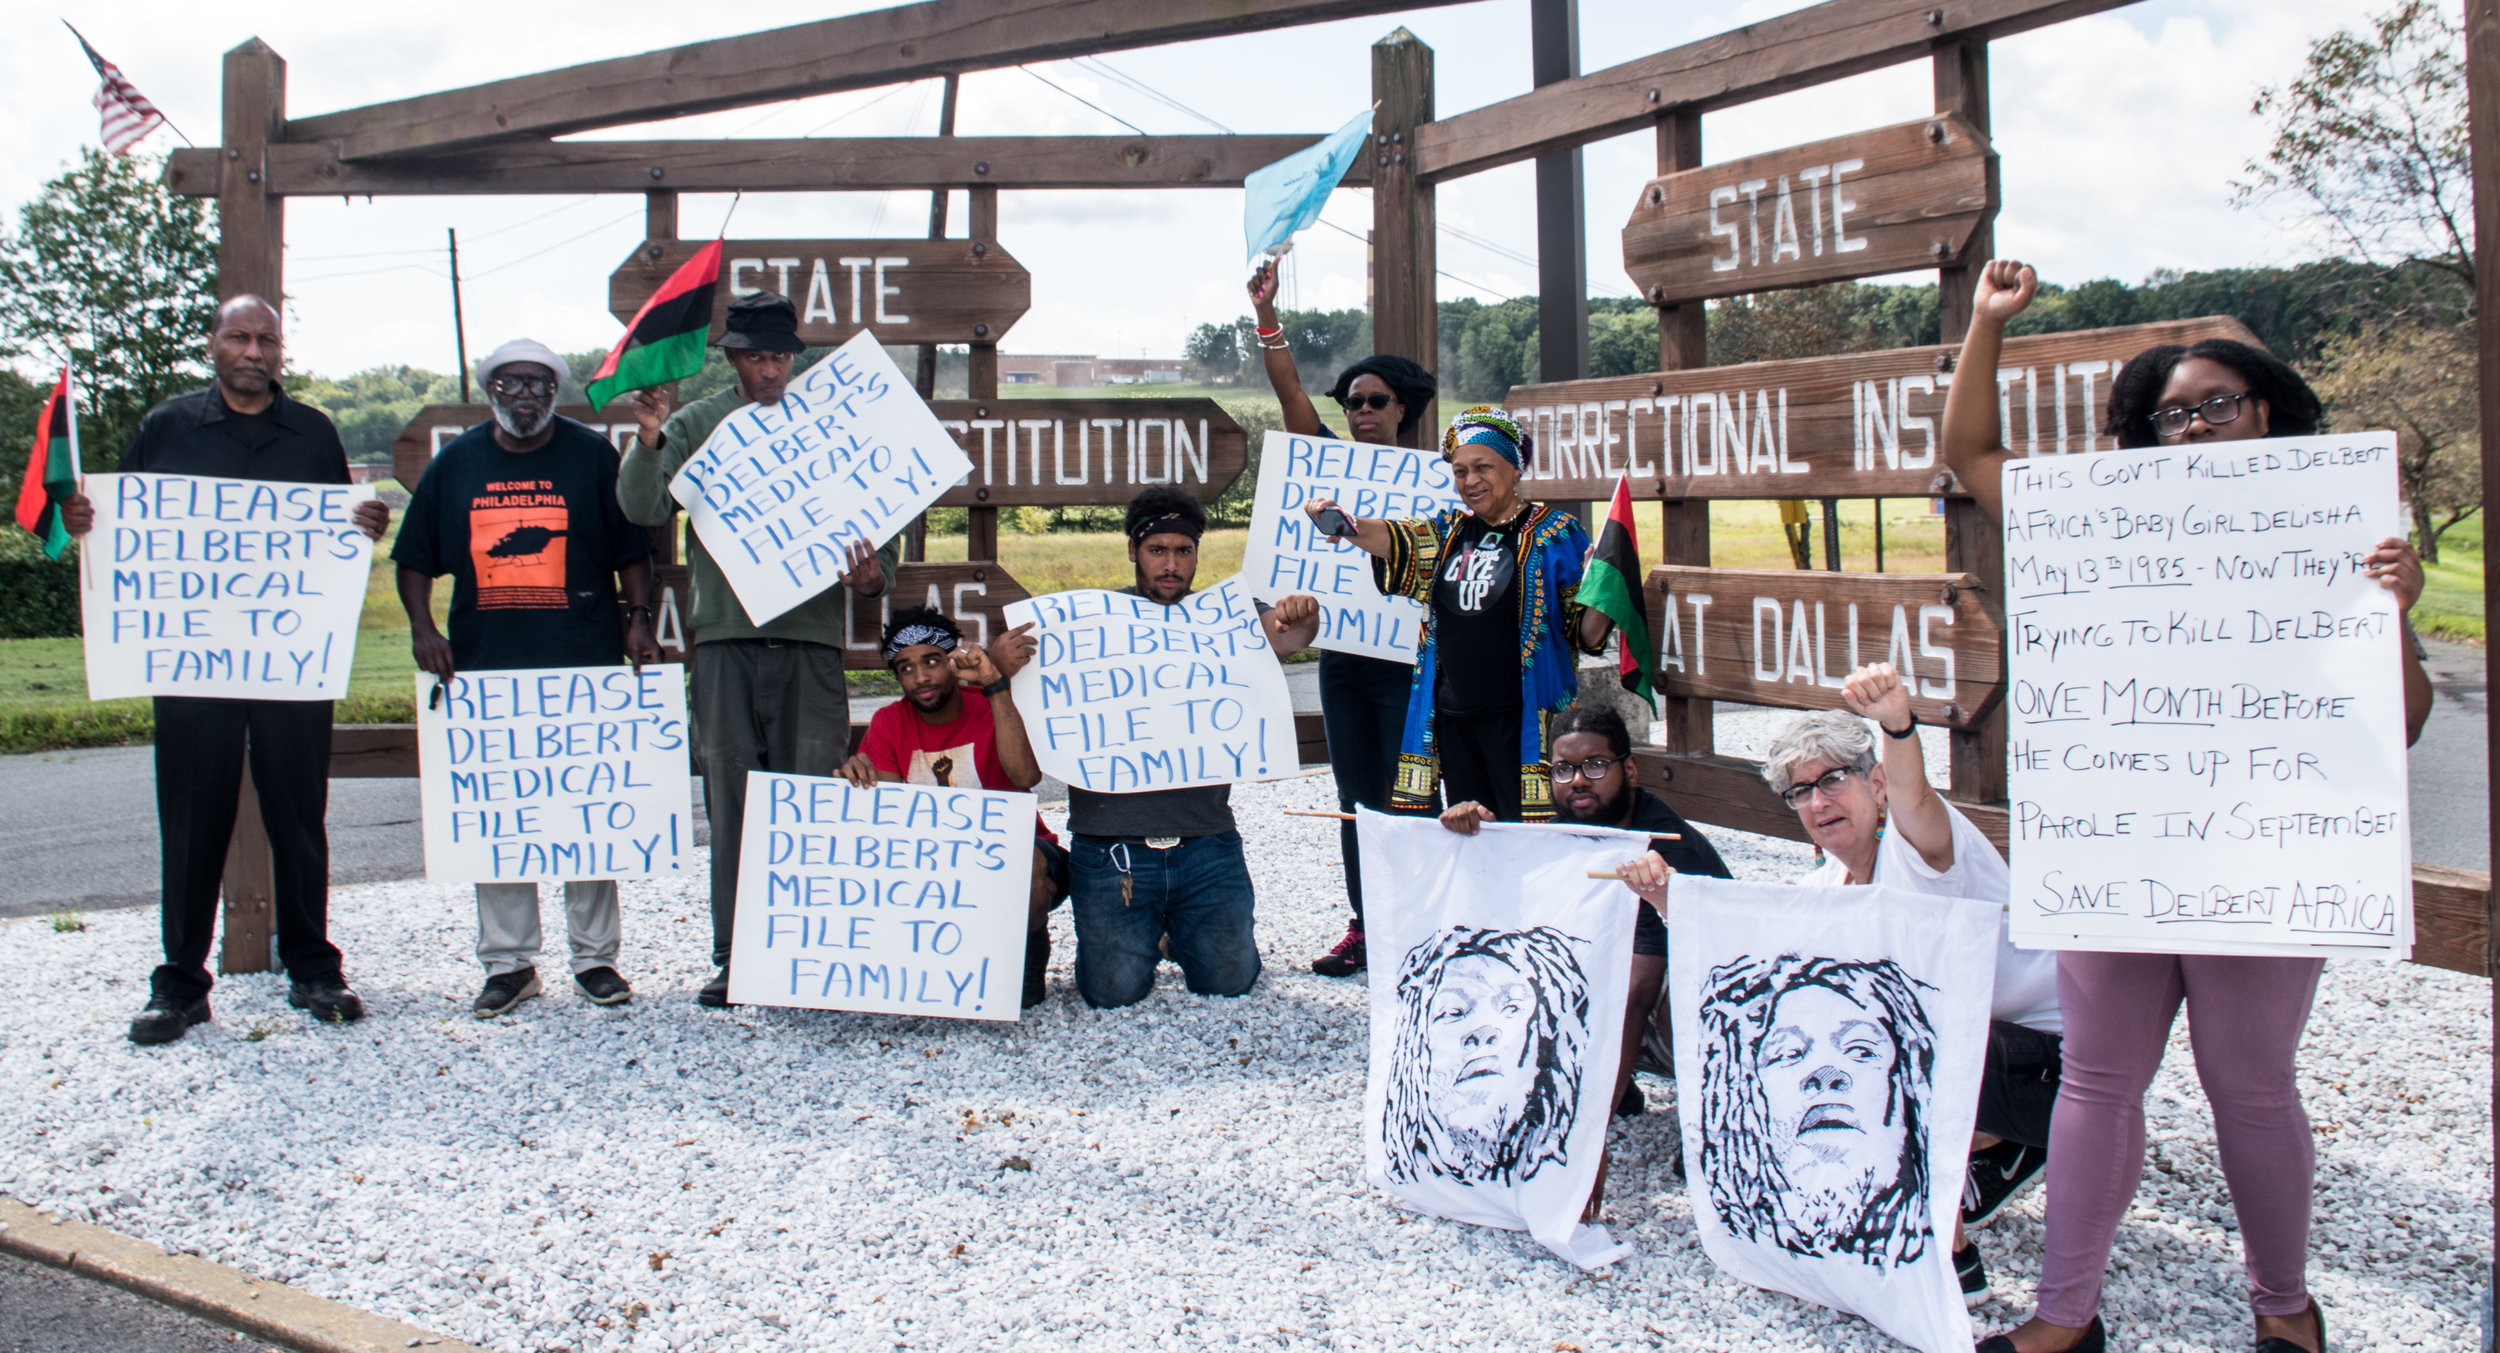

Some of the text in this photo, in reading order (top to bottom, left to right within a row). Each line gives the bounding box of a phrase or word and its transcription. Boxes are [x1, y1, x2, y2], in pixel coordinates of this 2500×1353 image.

[1710, 158, 1867, 272] STATE
[730, 257, 910, 324] STATE
[683, 352, 863, 493] RELEASE
[703, 372, 889, 511] DELBERT'S
[486, 480, 553, 492] WELCOME TO
[719, 434, 873, 533] MEDICAL
[1286, 437, 1460, 495] RELEAS
[2089, 458, 2171, 486] GOV'T
[2287, 446, 2389, 471] DELBERT
[117, 475, 349, 523] RELEASE
[472, 494, 566, 508] PHILADELPHIA
[740, 445, 891, 564] FILE TO
[781, 447, 937, 588] FAMILY!
[114, 526, 362, 563] DELBERT'S
[2110, 507, 2173, 542] BABY
[113, 569, 324, 602] MEDICAL
[1270, 554, 1359, 595] FILE
[2129, 556, 2184, 583] 1985
[2216, 555, 2279, 580] NOW
[113, 608, 301, 643] FILE TO
[1031, 581, 1246, 629] RELEASE
[146, 631, 333, 688] FAMILY!
[1039, 616, 1267, 668] DELBERT'S
[1661, 593, 1955, 700] AT DALLAS
[2009, 610, 2114, 663] TRYING
[2121, 620, 2162, 646] TO
[2247, 610, 2389, 644] DELBERT
[444, 671, 664, 720] RELEASE
[1041, 662, 1250, 709] MEDICAL
[2015, 678, 2355, 724] ONE MONTH BEFORE
[447, 712, 683, 764] DELBERT'S
[1045, 697, 1243, 752] FILE TO
[1077, 717, 1268, 791] FAMILY!
[2014, 738, 2327, 787] HE COMES UP FOR
[451, 760, 652, 804] MEDICAL
[769, 778, 1009, 834] RELEASE
[452, 801, 635, 843] FILE TO
[2017, 801, 2137, 840] PAROLE
[2152, 812, 2215, 840] IN
[492, 813, 680, 878] FAMILY!
[768, 830, 1007, 871] DELBERT'S
[768, 870, 978, 909] MEDICAL
[2033, 870, 2128, 913] SAVE
[2140, 878, 2280, 918] DELBERT
[766, 914, 962, 956] FILE TO
[790, 957, 989, 1012] FAMILY!
